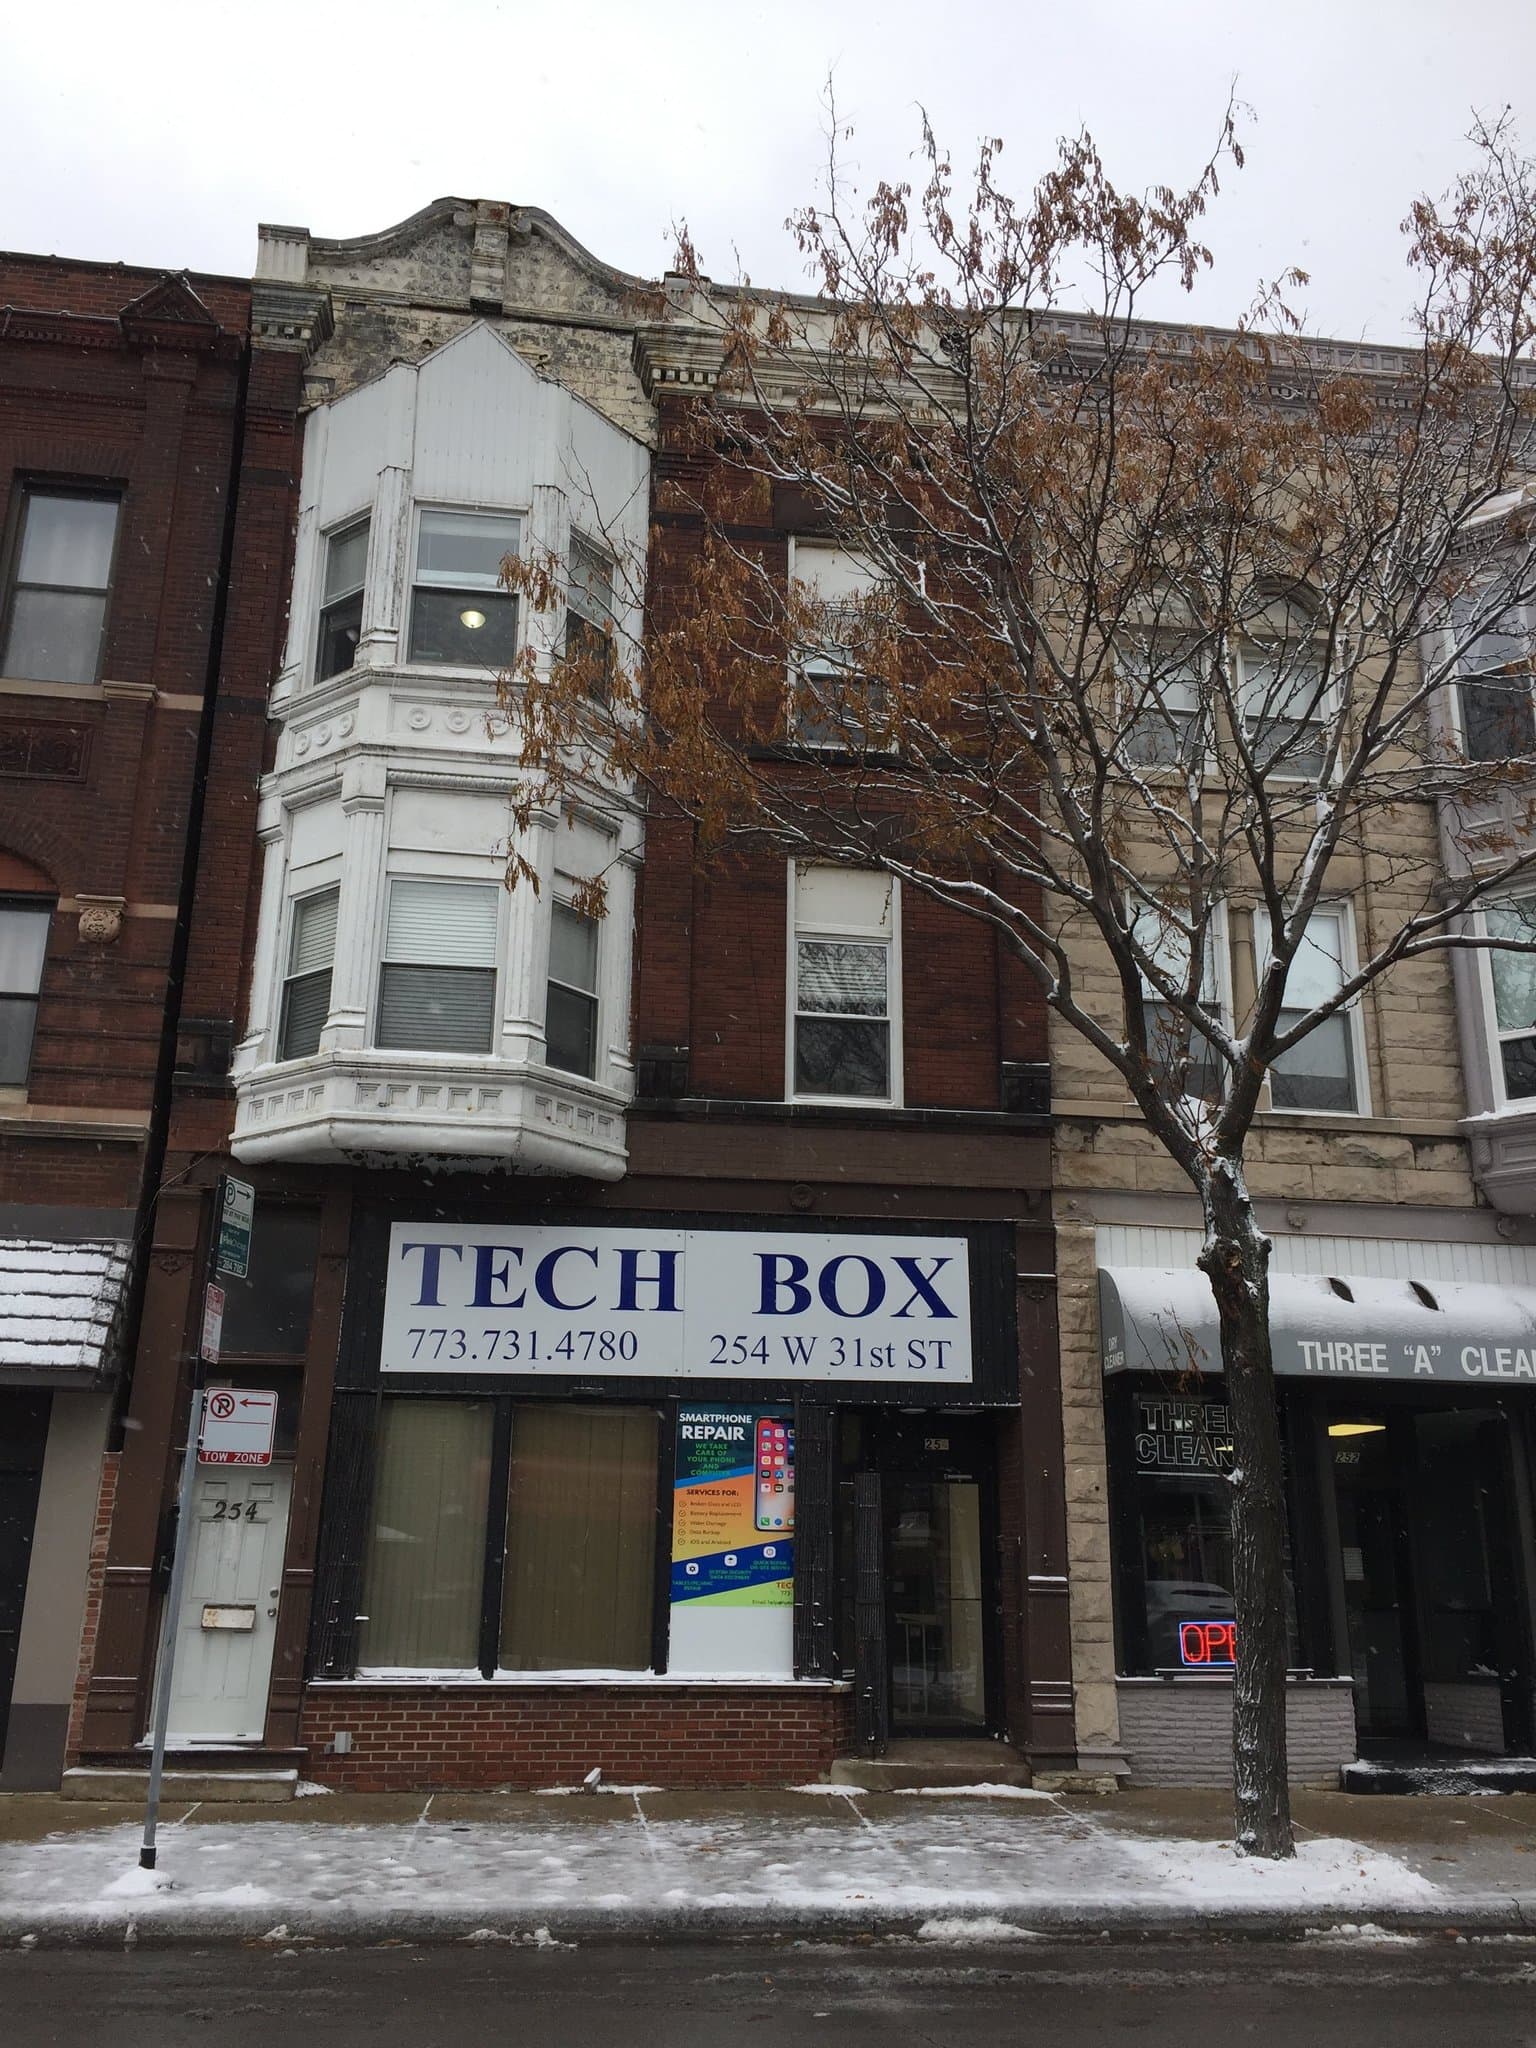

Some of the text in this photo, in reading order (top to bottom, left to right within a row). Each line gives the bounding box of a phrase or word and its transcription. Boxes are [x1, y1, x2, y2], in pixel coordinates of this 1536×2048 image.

[401, 1243, 959, 1318] TECH BOX
[407, 1328, 638, 1361] 773.731.4780
[709, 1334, 952, 1370] 254 W 31st ST
[1297, 1341, 1389, 1373] THREE
[679, 1413, 752, 1424] SMARTPHONE
[682, 1425, 745, 1440] REPAIR
[204, 1452, 264, 1464] TOW ZONE
[213, 1501, 258, 1521] 254
